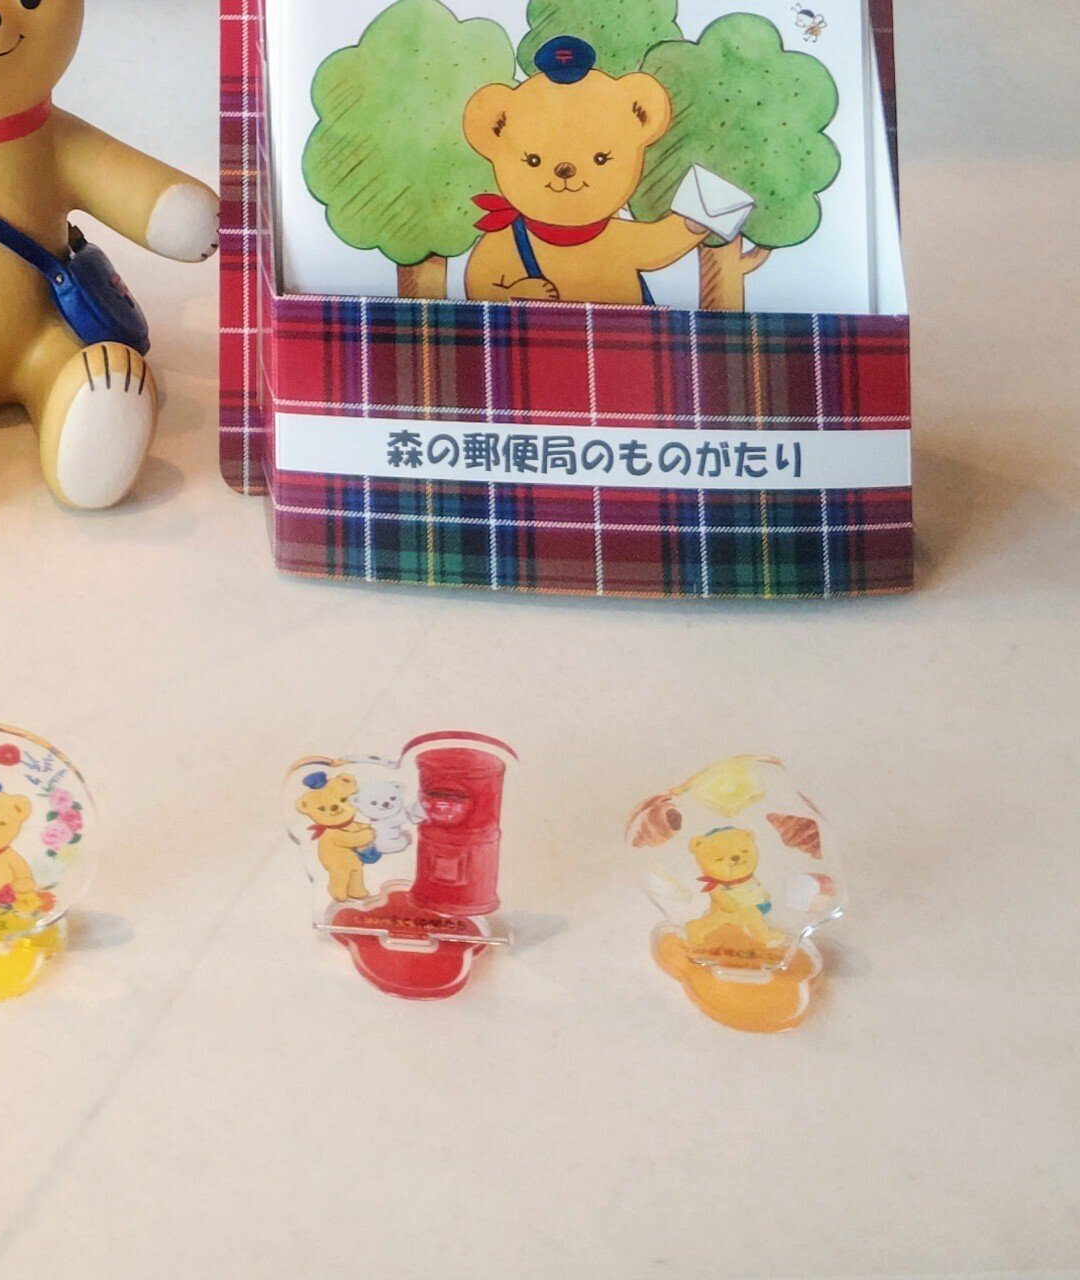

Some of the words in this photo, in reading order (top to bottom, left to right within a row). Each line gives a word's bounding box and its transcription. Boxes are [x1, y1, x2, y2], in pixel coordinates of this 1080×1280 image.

[386, 431, 803, 478] 森の郵便局のものがたり
